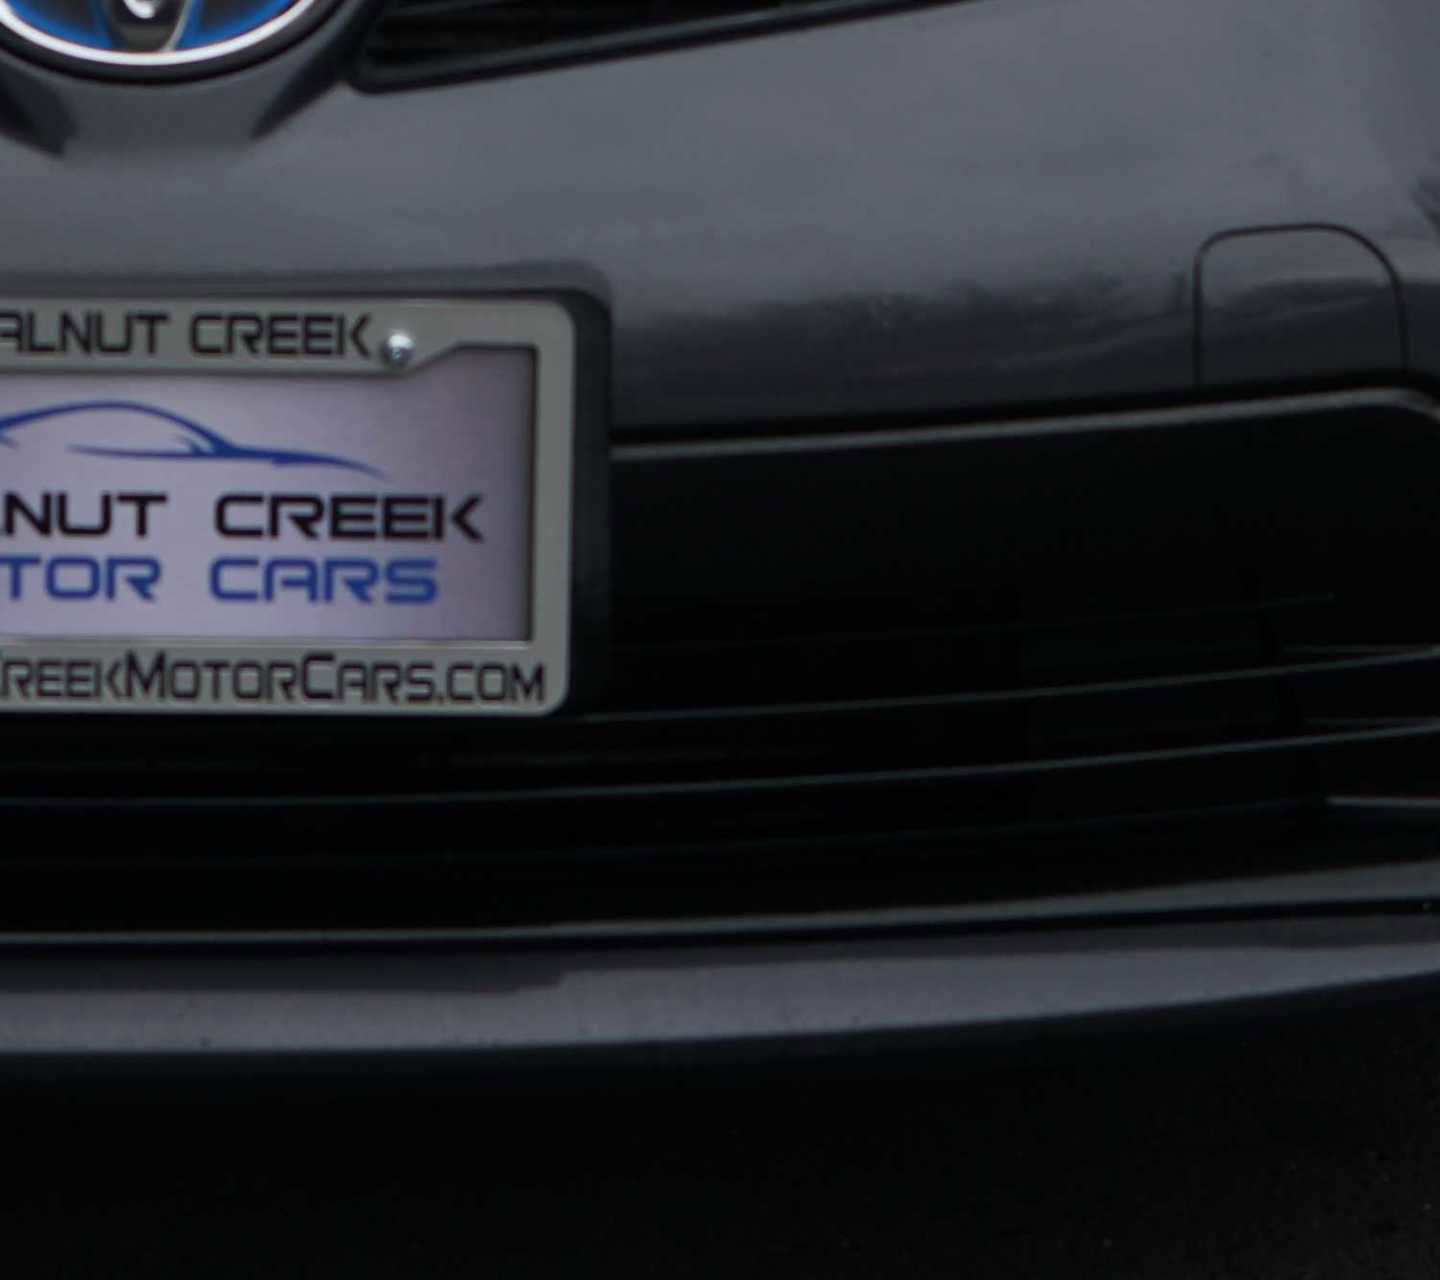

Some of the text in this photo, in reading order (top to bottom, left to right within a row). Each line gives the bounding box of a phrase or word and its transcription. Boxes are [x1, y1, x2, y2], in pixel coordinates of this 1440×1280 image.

[190, 311, 372, 358] CREEK
[214, 492, 485, 542] CREEK
[209, 555, 439, 605] CARS
